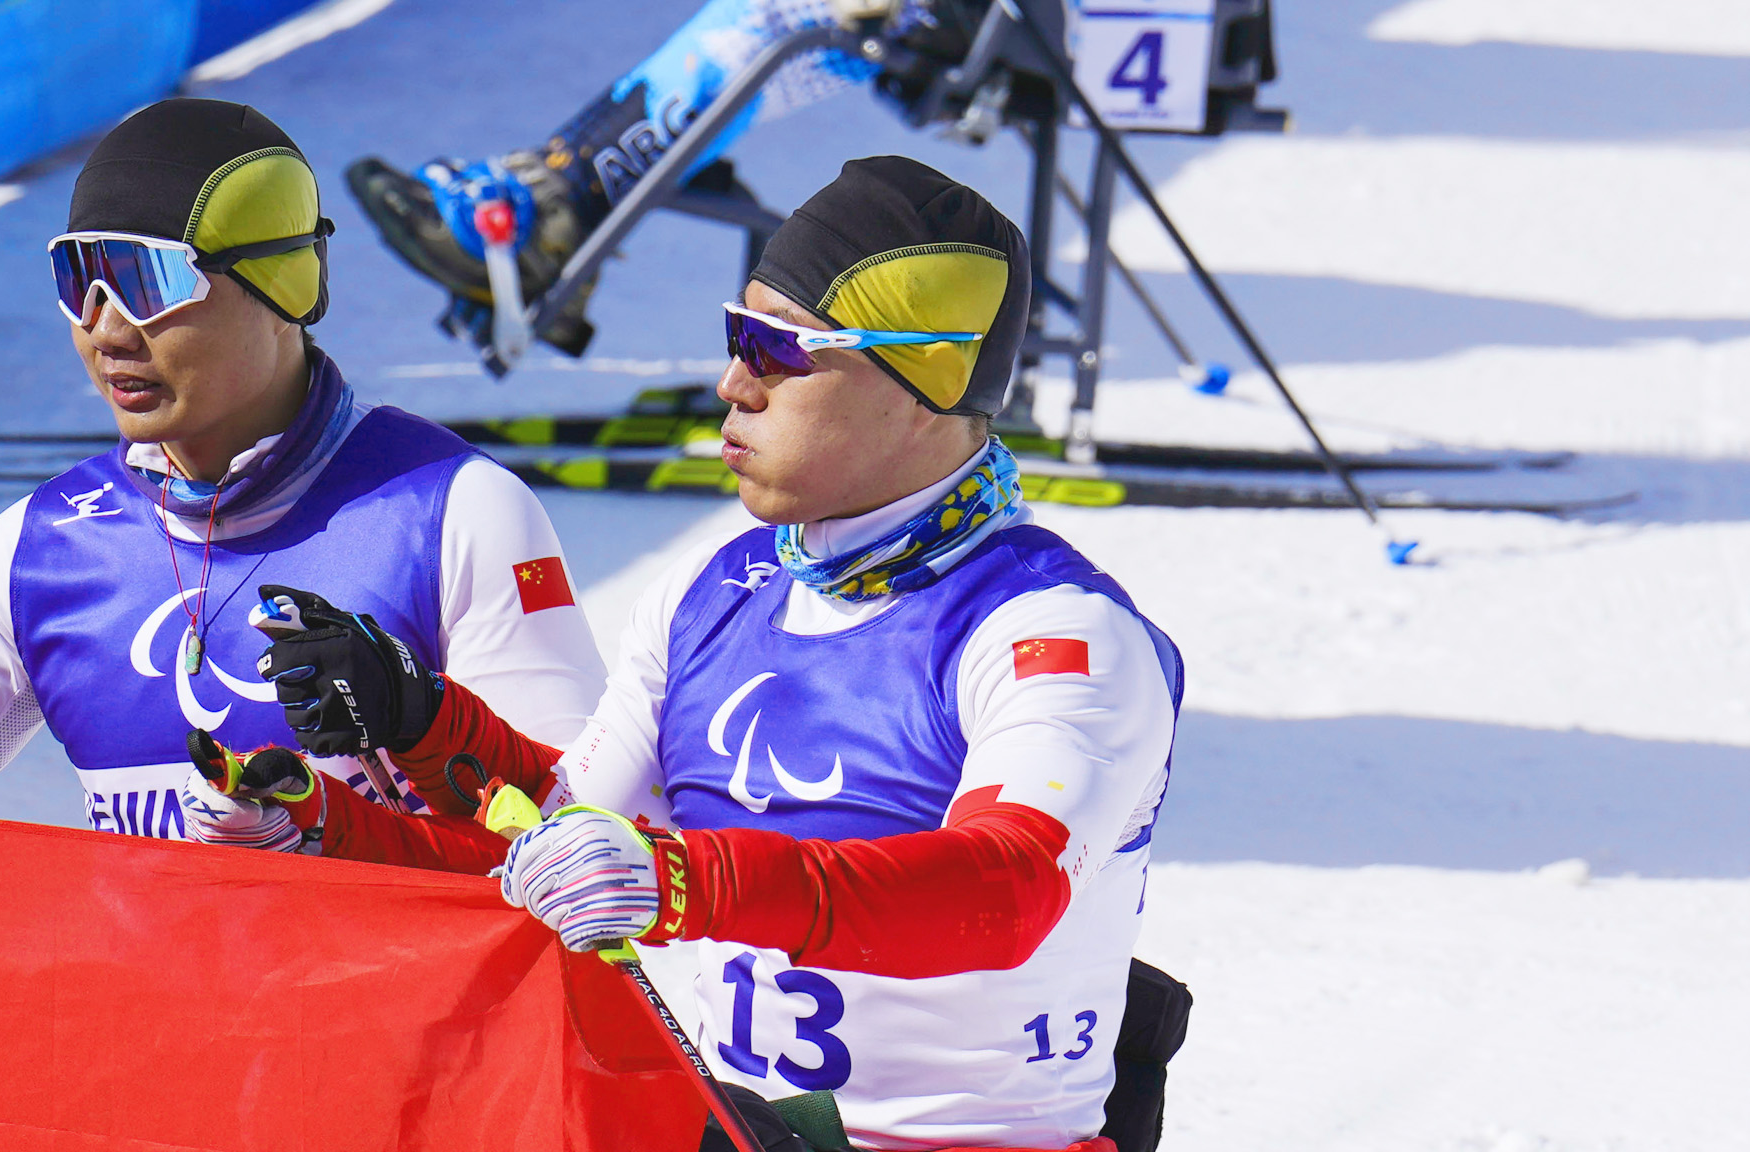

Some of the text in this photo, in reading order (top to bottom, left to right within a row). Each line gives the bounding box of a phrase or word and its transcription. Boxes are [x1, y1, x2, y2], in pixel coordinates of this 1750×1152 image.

[1107, 31, 1168, 104] 4
[343, 694, 370, 749] ELITE
[664, 850, 687, 934] LEKI
[658, 1007, 679, 1030] 4.0
[672, 1032, 711, 1077] AERO
[717, 950, 851, 1091] 13
[1023, 1009, 1098, 1063] 13
